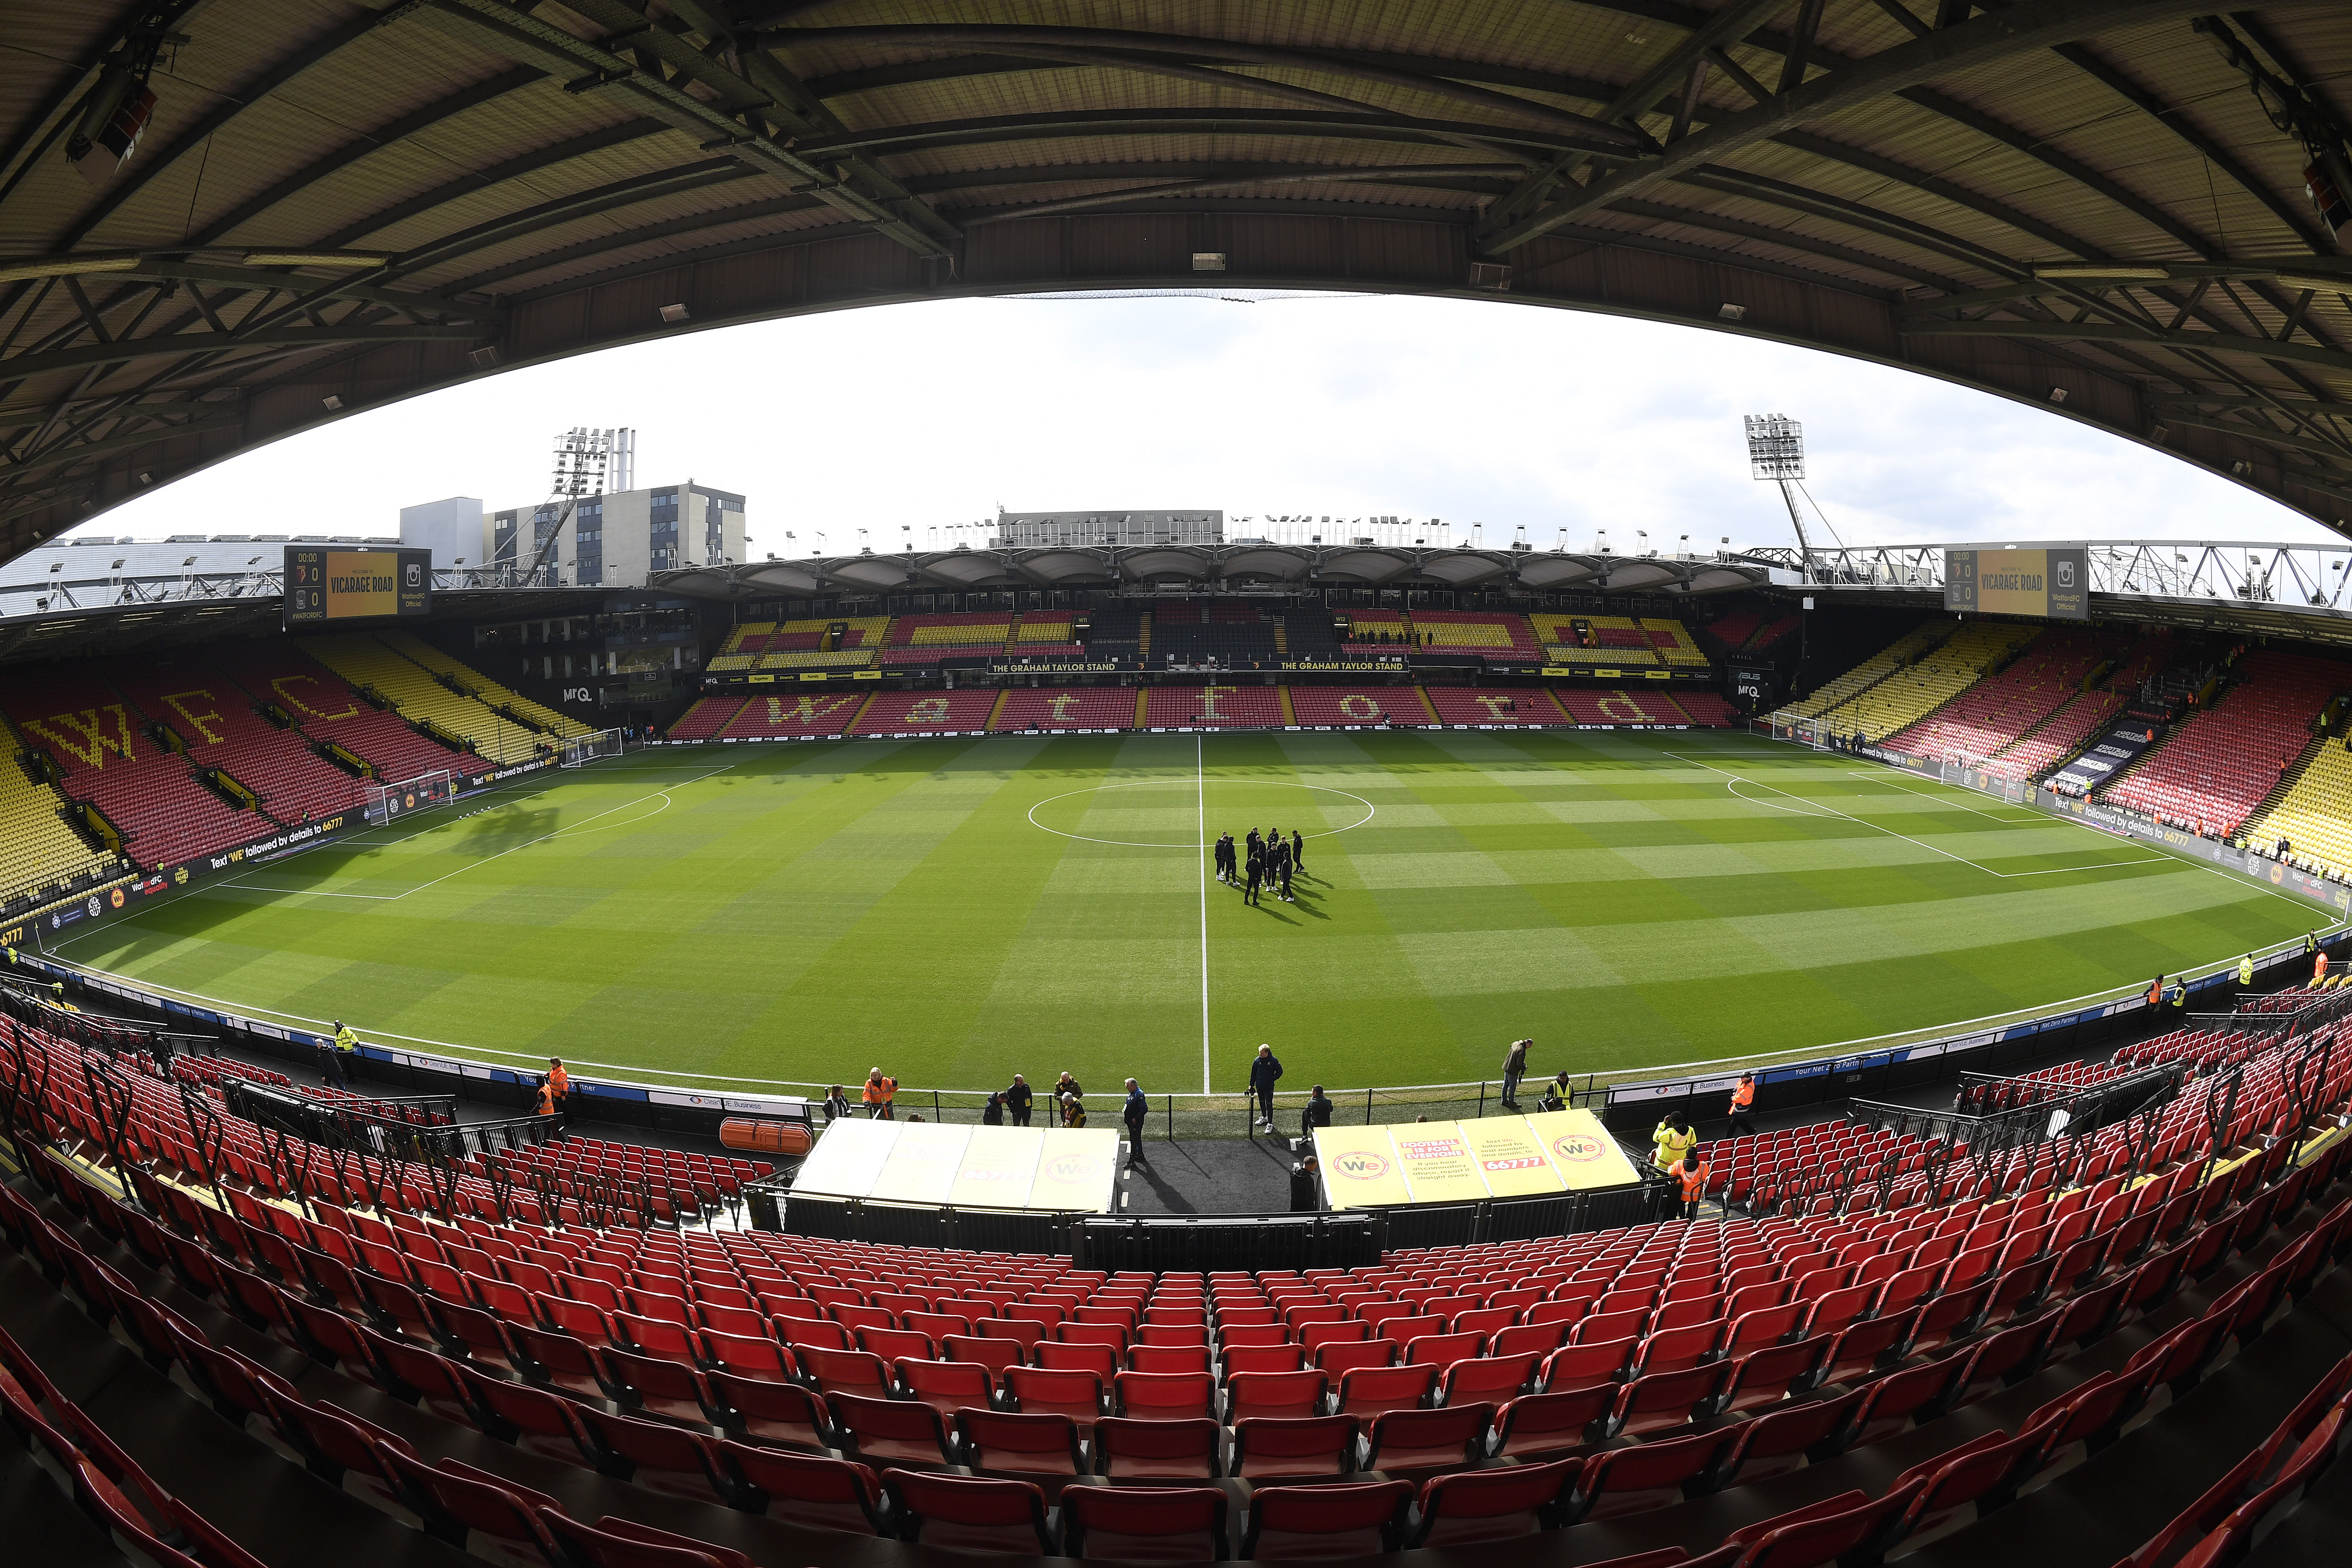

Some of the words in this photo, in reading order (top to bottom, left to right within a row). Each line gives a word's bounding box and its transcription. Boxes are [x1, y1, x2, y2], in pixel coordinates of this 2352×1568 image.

[299, 553, 317, 562] 00:00
[1954, 552, 1969, 560] 00:00
[312, 568, 318, 582] 0
[1965, 565, 1971, 577] 0
[331, 577, 370, 593] VICARAGE
[373, 576, 393, 592] ROAD
[1982, 574, 2018, 590] VICARAGE
[2021, 575, 2042, 591] ROAD
[312, 592, 318, 606] 0
[1965, 587, 1971, 600] 0
[1087, 663, 1115, 671] STAND
[564, 687, 592, 702] MrQ
[1738, 685, 1760, 698] MrQ
[2093, 748, 2131, 759] MANAGER
[2098, 744, 2134, 756] FOOTBALL
[1876, 749, 1882, 759] by
[1883, 751, 1900, 763] details
[1901, 756, 1906, 764] to
[1907, 757, 1924, 768] 66777
[2058, 749, 2083, 768] DESIGNATED
[2078, 757, 2113, 769] FOOTBALL
[473, 777, 484, 786] Text
[516, 766, 523, 775] by
[545, 756, 558, 766] 66777
[2074, 761, 2112, 772] MANAGER
[2055, 798, 2069, 810] Text
[2085, 806, 2116, 823] followed
[2117, 815, 2127, 828] by
[2128, 819, 2154, 836] details
[2155, 827, 2162, 839] to
[2164, 830, 2189, 847] 66777
[210, 855, 227, 869] Text
[245, 842, 277, 858] followed
[279, 837, 288, 848] by
[289, 827, 313, 844] details
[314, 824, 322, 834] to
[322, 817, 343, 832] 66777
[2248, 856, 2260, 868] KICK
[2248, 865, 2260, 876] OUT
[2272, 869, 2281, 879] We
[175, 873, 188, 882] FAMILY
[145, 881, 168, 895] equality
[2302, 885, 2326, 901] equality
[88, 897, 101, 910] KICK
[89, 906, 101, 917] OUT
[2061, 1016, 2077, 1025] Partner
[1949, 1037, 1986, 1049] ClearVUE.Business
[1813, 1065, 1824, 1073] Net
[2339, 1115, 2348, 1128] M
[61, 1142, 71, 1156] M
[1401, 1140, 1457, 1148] FOOTBALL
[1562, 1144, 1596, 1154] We
[2264, 1138, 2270, 1149] L
[1405, 1151, 1463, 1159] EVERYONE
[1056, 1164, 1090, 1174] We
[1343, 1160, 1379, 1171] We
[1486, 1157, 1541, 1170] 66777
[2067, 1183, 2074, 1191] H
[293, 1193, 298, 1202] J
